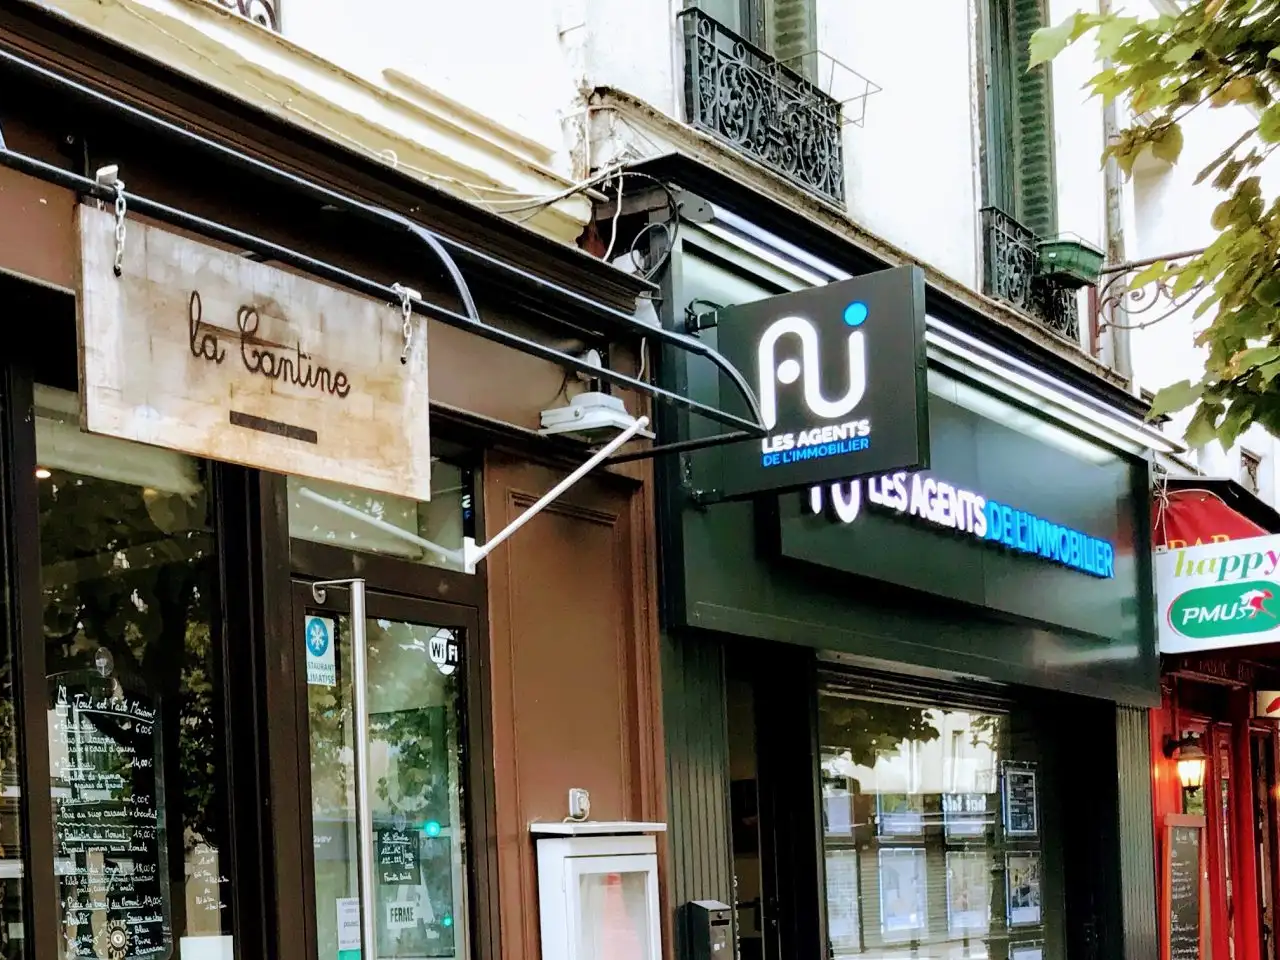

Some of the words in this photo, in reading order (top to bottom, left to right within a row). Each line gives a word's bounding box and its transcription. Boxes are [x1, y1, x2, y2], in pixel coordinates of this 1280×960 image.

[188, 290, 225, 365] la
[237, 304, 351, 398] Cantine
[761, 433, 795, 455] LES
[797, 419, 871, 449] AGENTS
[763, 453, 782, 467] DE
[783, 438, 870, 464] L'IMMOBILIER
[868, 471, 909, 512] LES
[910, 473, 988, 538] AGENTS
[988, 501, 1014, 545] DE
[1181, 602, 1239, 626] PMU
